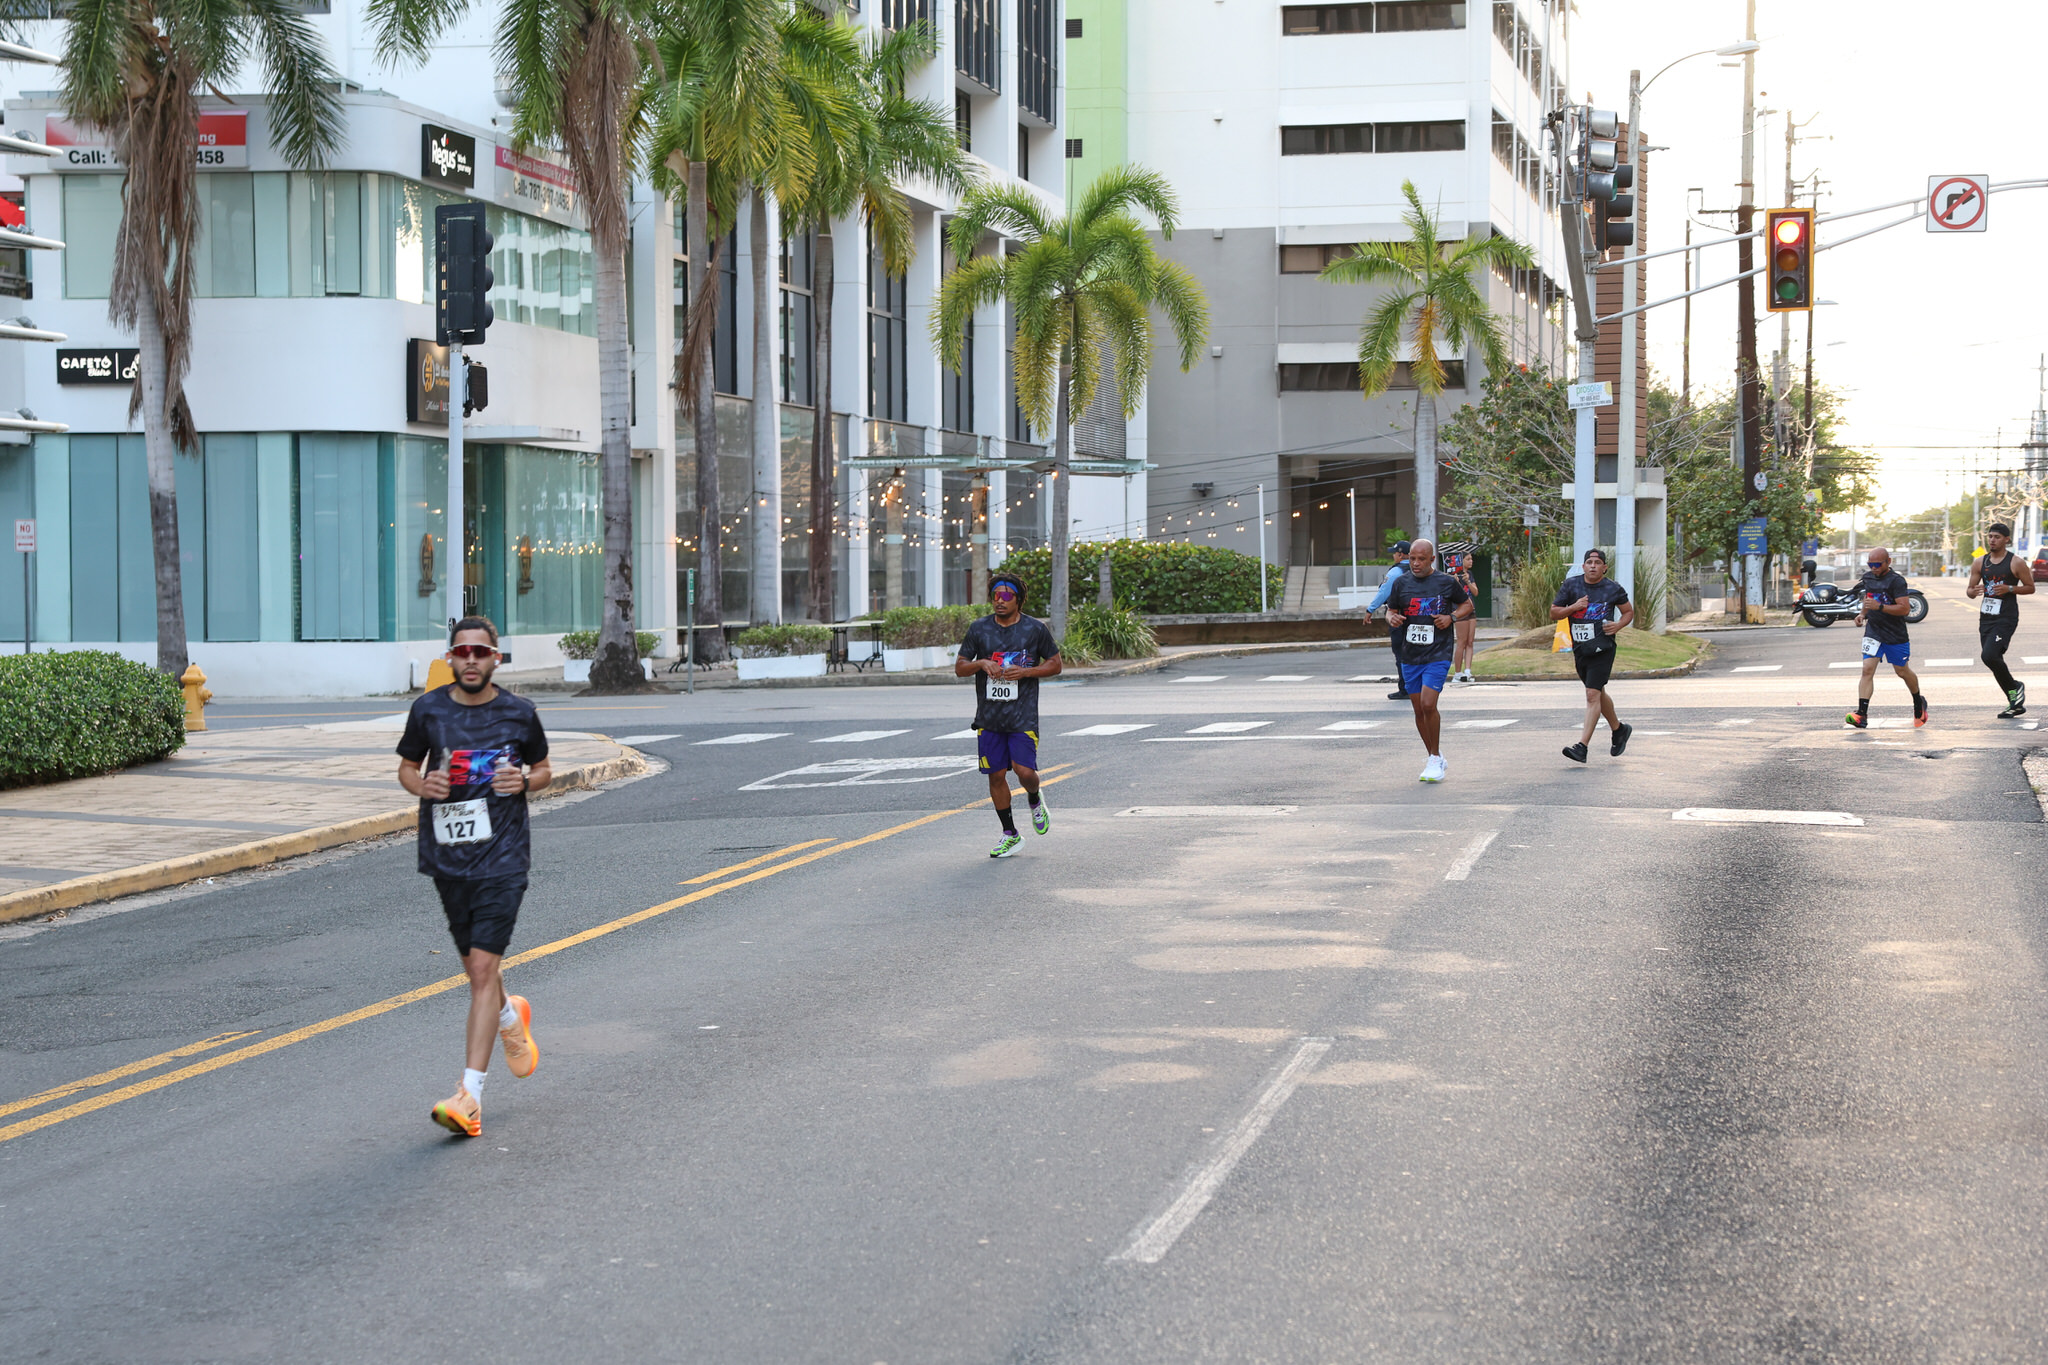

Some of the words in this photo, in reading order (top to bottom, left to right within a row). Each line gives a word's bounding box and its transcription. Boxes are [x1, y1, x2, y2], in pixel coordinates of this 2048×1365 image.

[68, 150, 106, 165] Call:
[432, 138, 456, 177] Regus
[20, 524, 31, 533] NO
[1408, 597, 1437, 611] 5K
[1985, 604, 1994, 612] 37
[1411, 633, 1428, 642] 216
[1575, 632, 1589, 640] 112
[992, 687, 1010, 698] 200
[450, 750, 503, 776] 5K
[445, 820, 476, 839] 127
